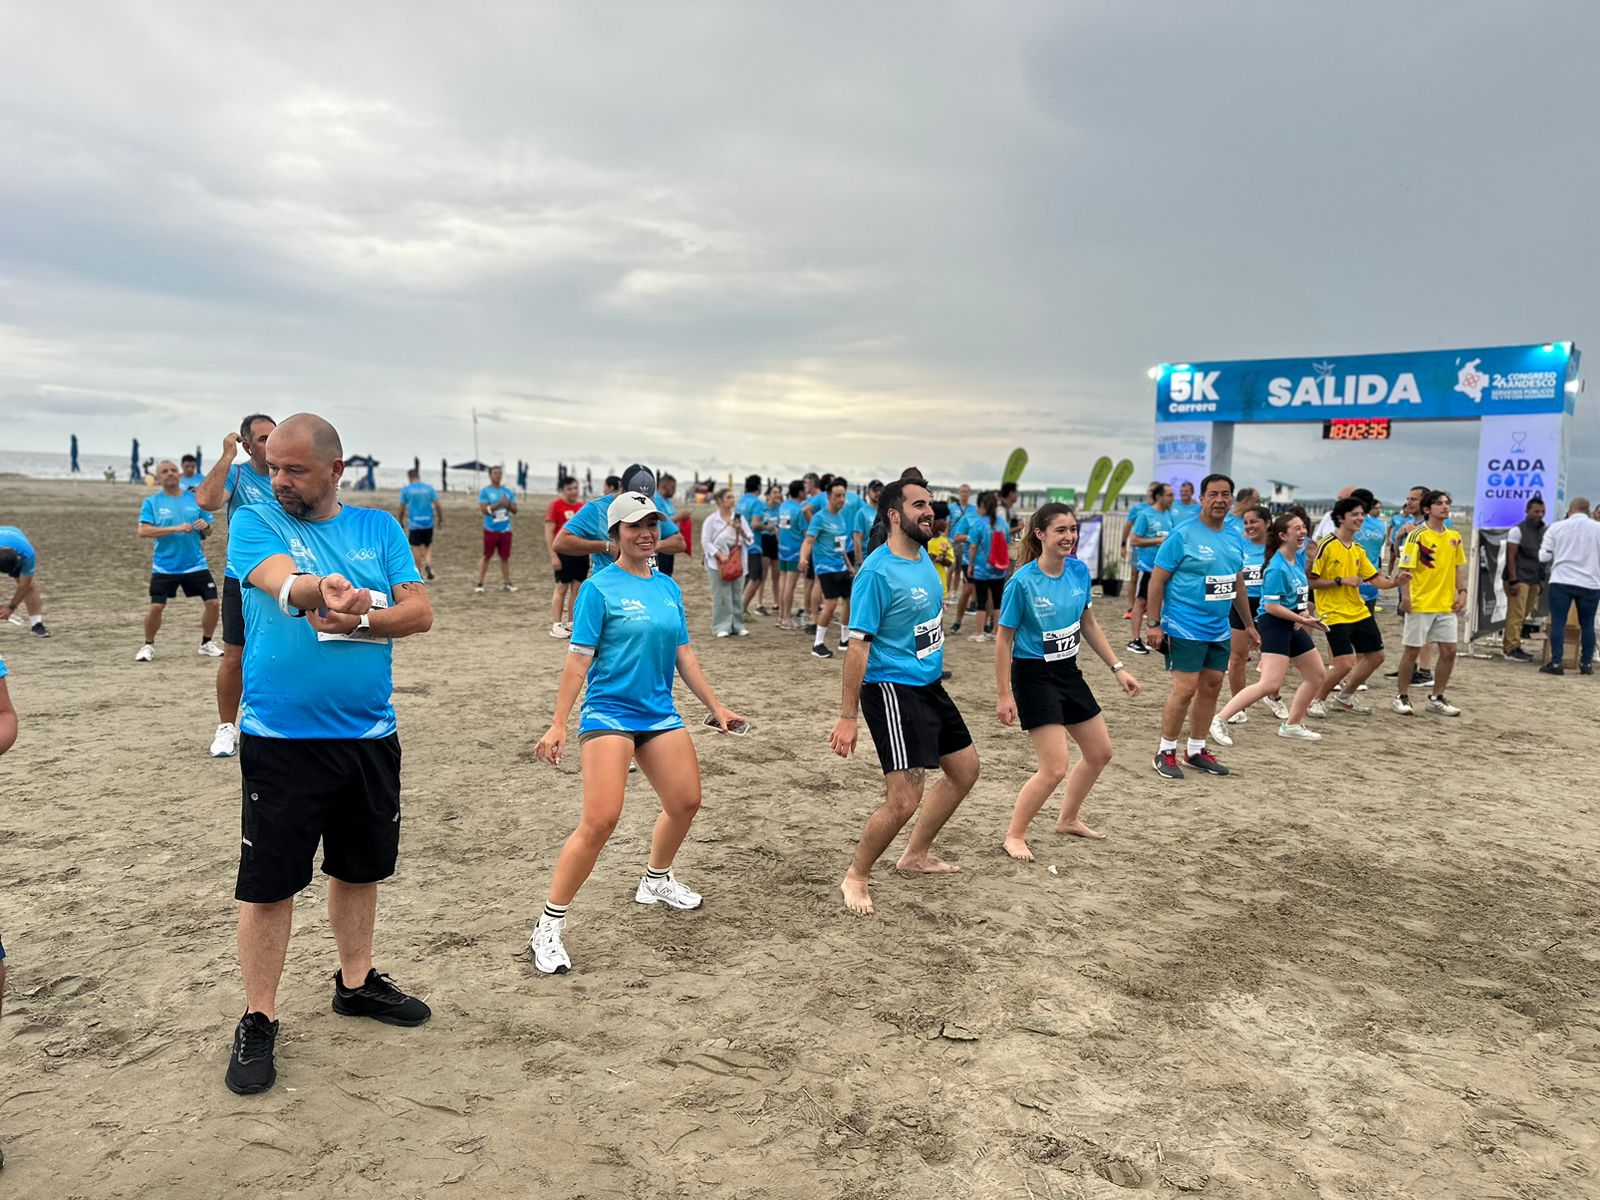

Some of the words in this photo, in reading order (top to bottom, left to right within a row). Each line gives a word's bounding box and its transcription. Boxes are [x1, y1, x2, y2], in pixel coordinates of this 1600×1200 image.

[1170, 371, 1220, 401] 5K
[1267, 373, 1422, 407] SALIDA
[1169, 402, 1216, 413] Carrera
[1488, 459, 1545, 471] CADA
[1485, 489, 1541, 499] CUENTA
[1214, 583, 1233, 594] 253
[1055, 635, 1076, 652] 172
